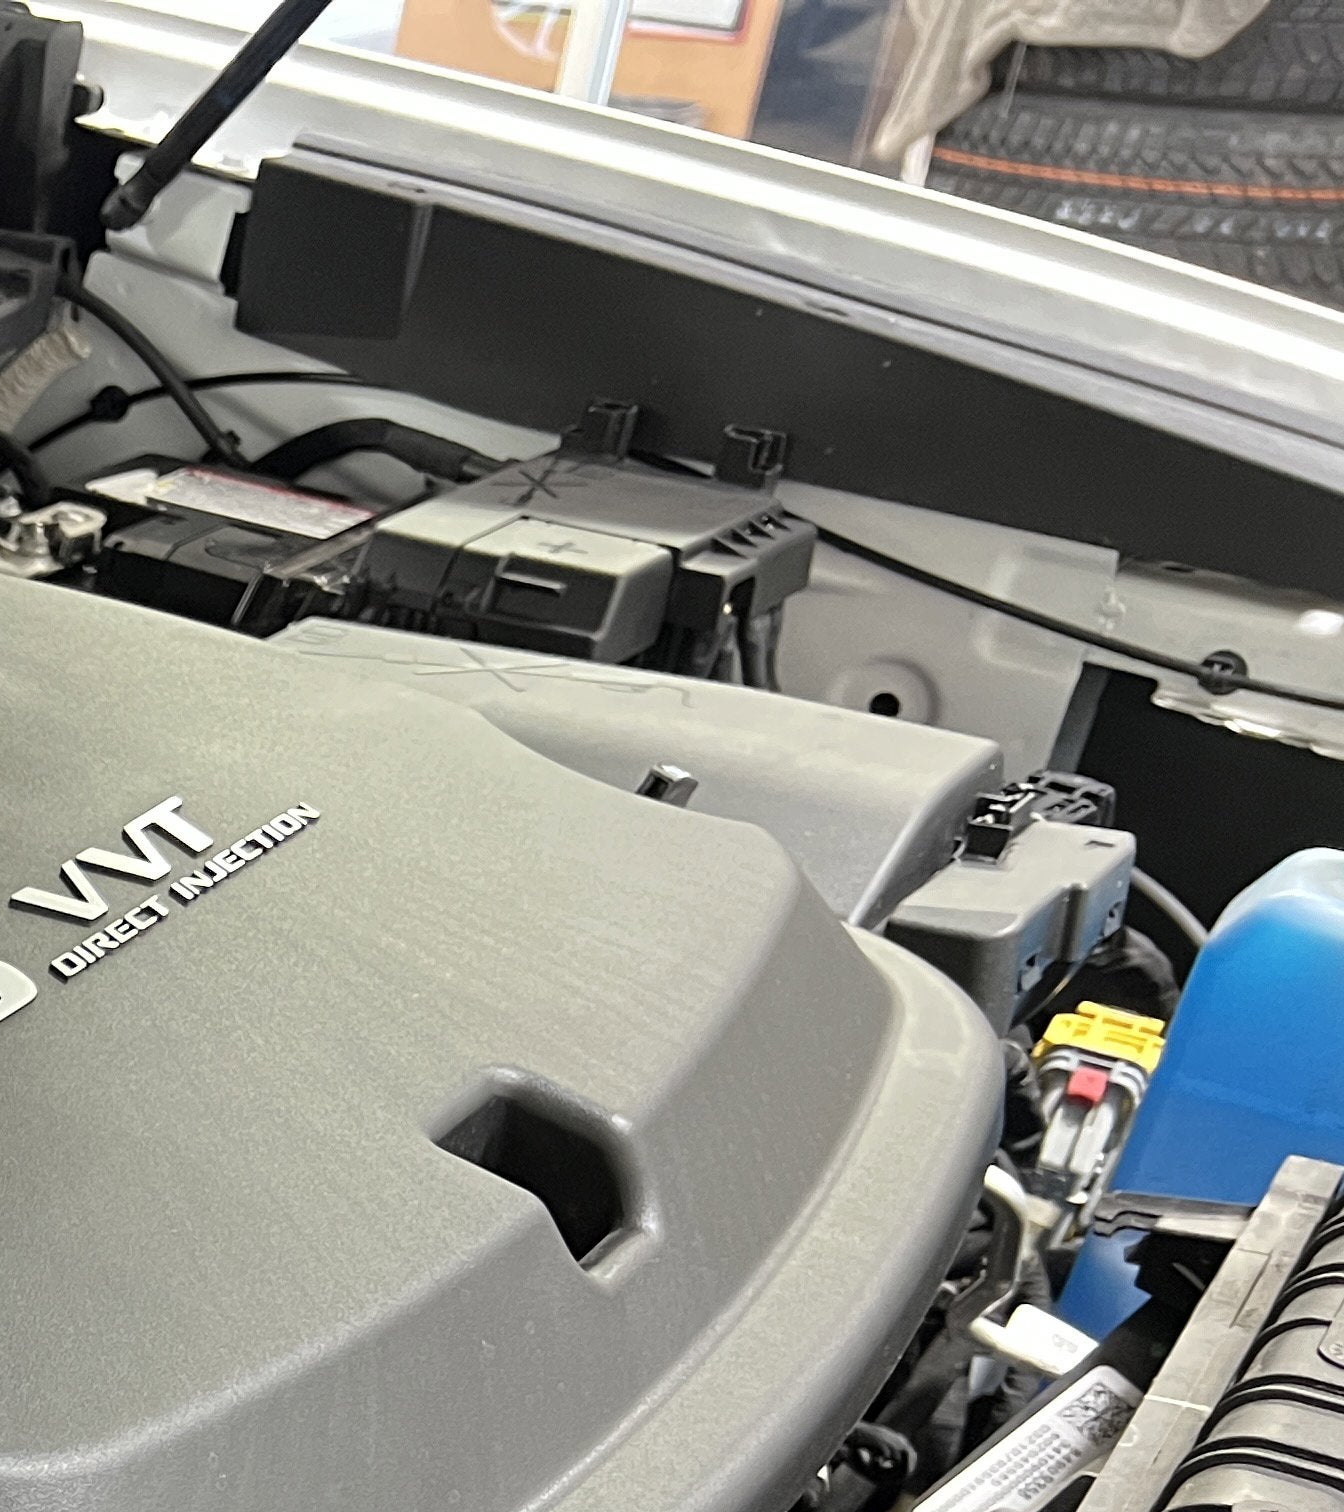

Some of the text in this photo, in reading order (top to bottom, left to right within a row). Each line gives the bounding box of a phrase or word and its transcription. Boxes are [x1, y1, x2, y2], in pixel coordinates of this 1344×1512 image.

[11, 795, 214, 921] VVT
[50, 801, 321, 979] DIRECT INJECTION
